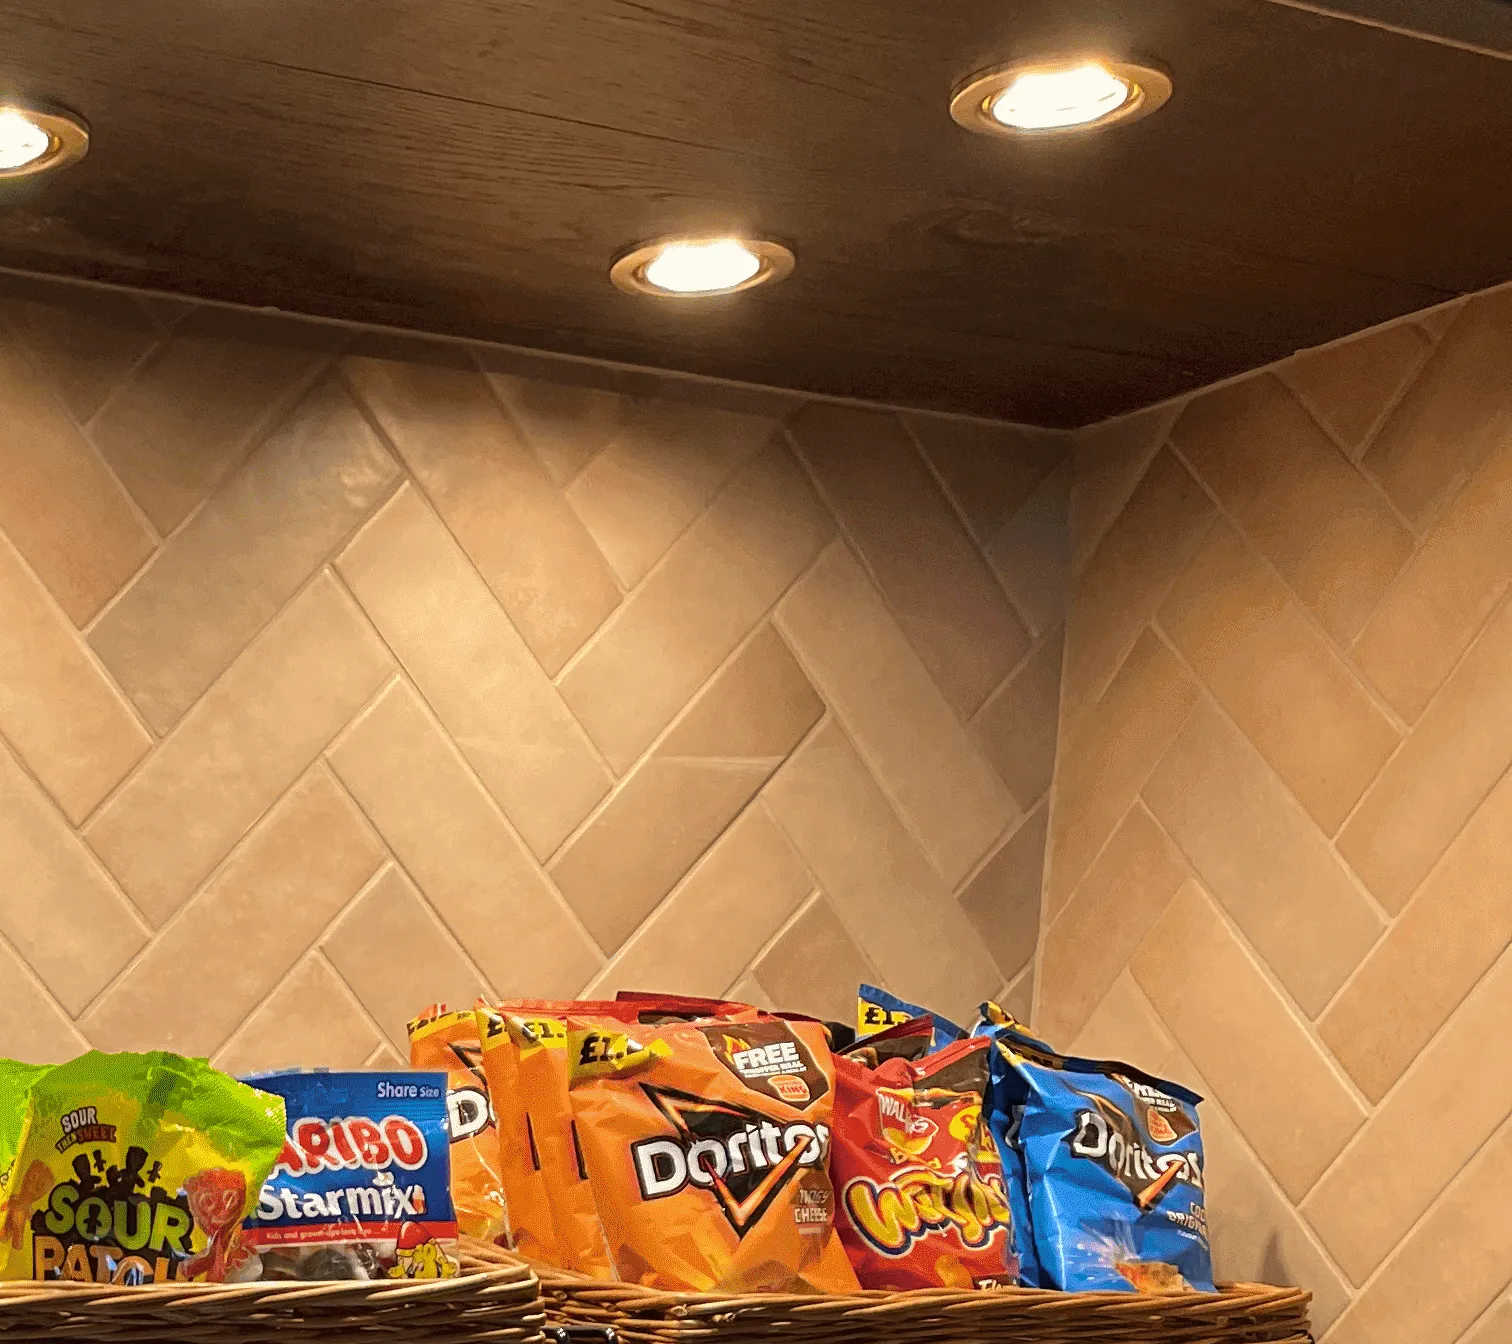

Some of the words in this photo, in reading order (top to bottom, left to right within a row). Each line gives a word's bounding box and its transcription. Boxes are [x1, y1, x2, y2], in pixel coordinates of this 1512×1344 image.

[733, 1042, 799, 1070] FREE
[377, 1082, 417, 1098] Share
[420, 1087, 439, 1098] Size
[61, 1106, 97, 1134] SOUR
[271, 1116, 428, 1178] ARIBO
[257, 1176, 416, 1220] Starmix
[43, 1184, 193, 1254] SOUR
